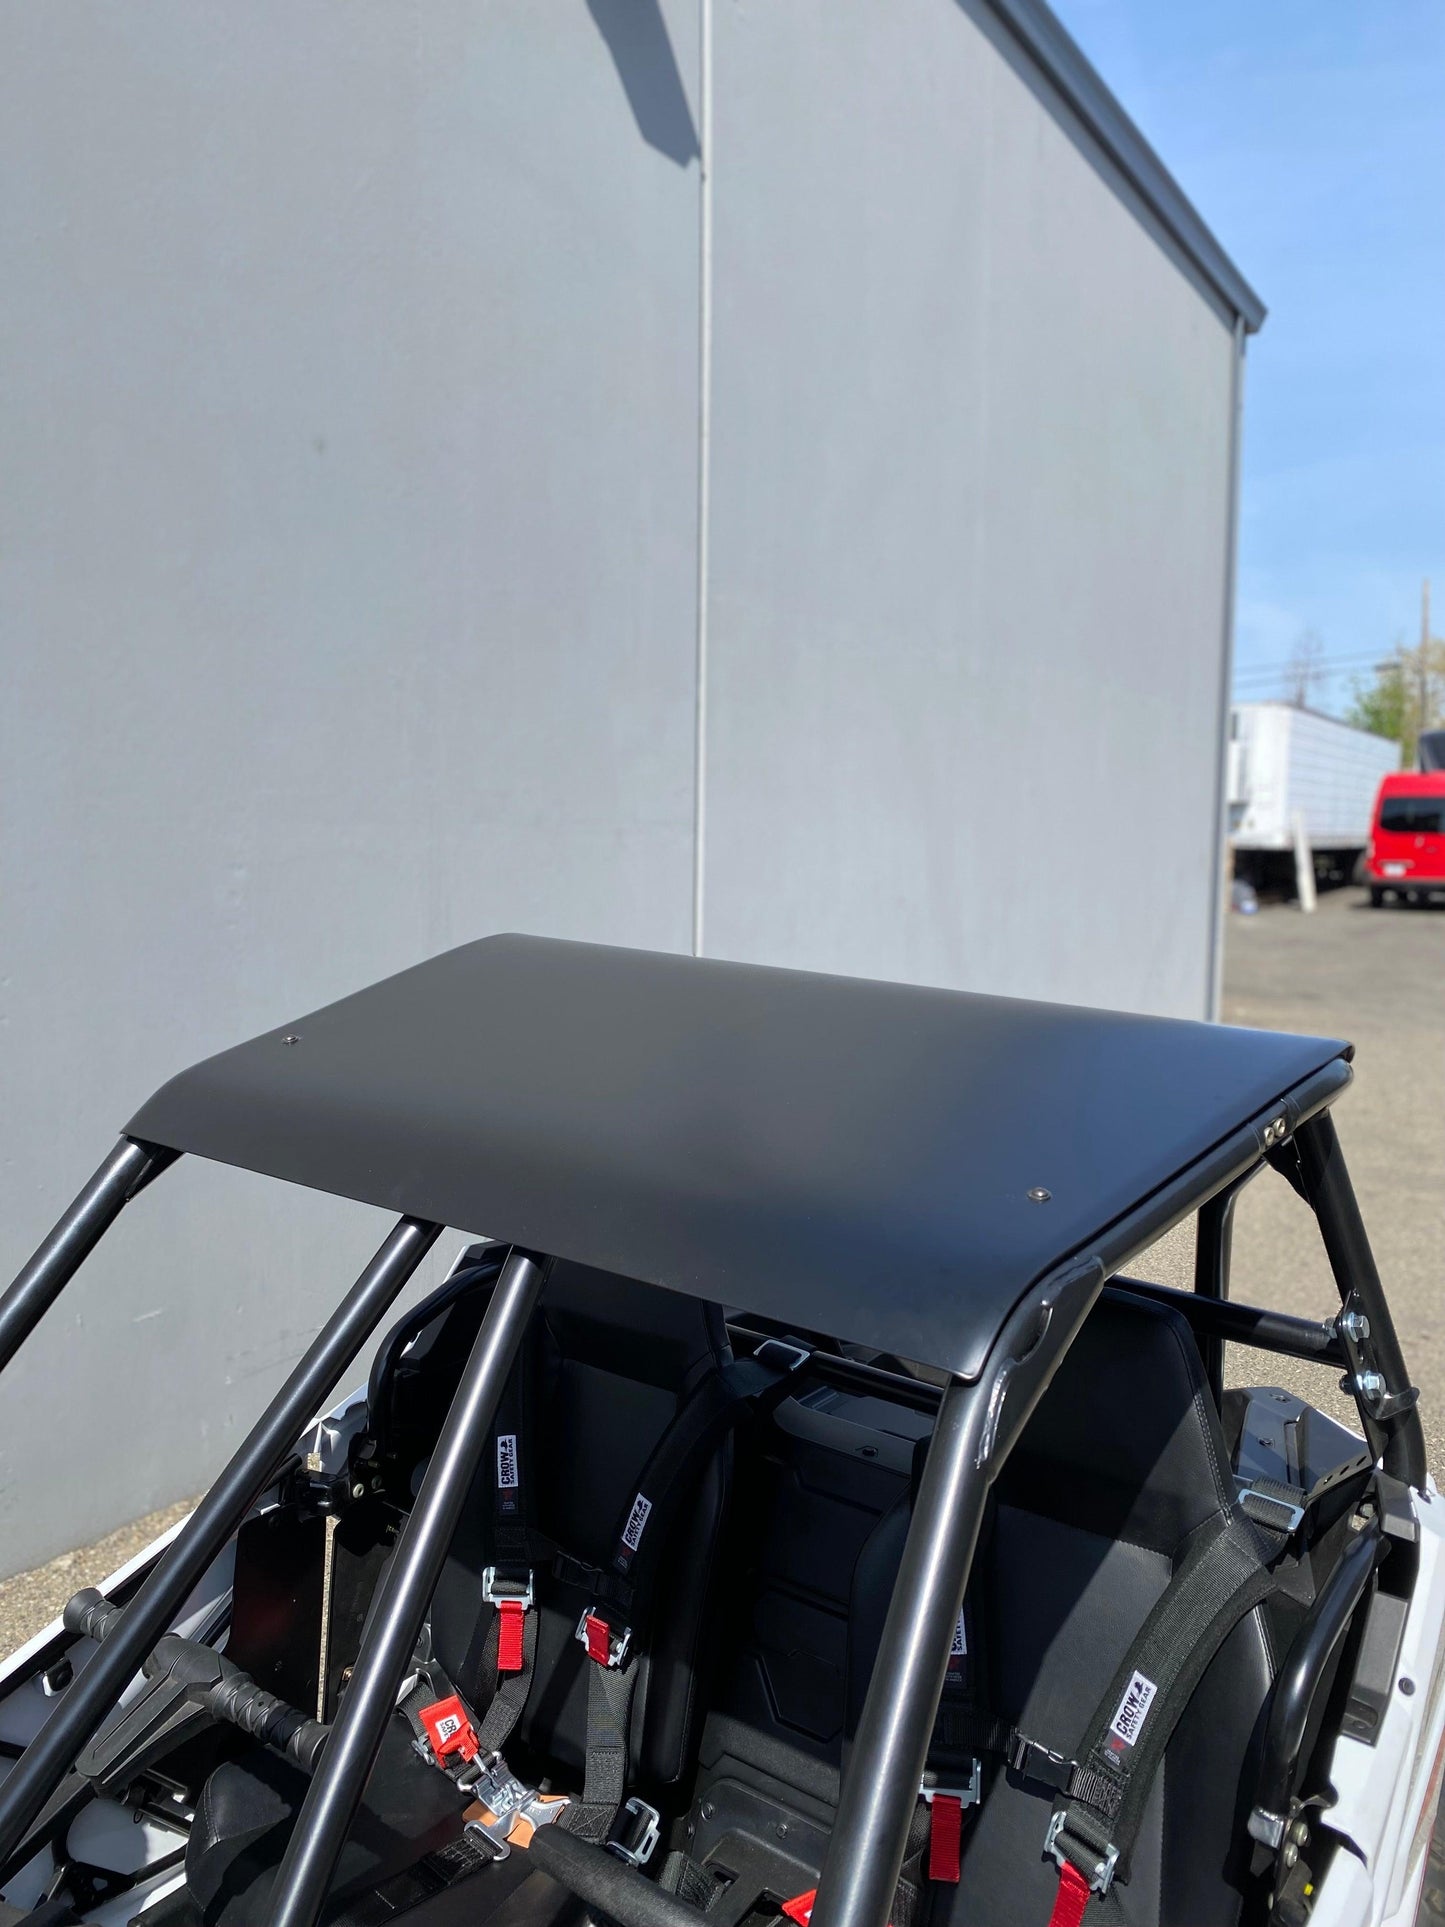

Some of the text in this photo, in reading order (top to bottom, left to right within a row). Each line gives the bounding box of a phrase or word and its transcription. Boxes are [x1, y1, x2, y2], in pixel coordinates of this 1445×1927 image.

[501, 1451, 511, 1485] CROW
[625, 1509, 640, 1544] CROW
[630, 1503, 649, 1547] SAFETY GEAR
[444, 1719, 457, 1733] CR
[1116, 1691, 1140, 1735] CROW
[1126, 1686, 1152, 1740] SAFETY GEAR
